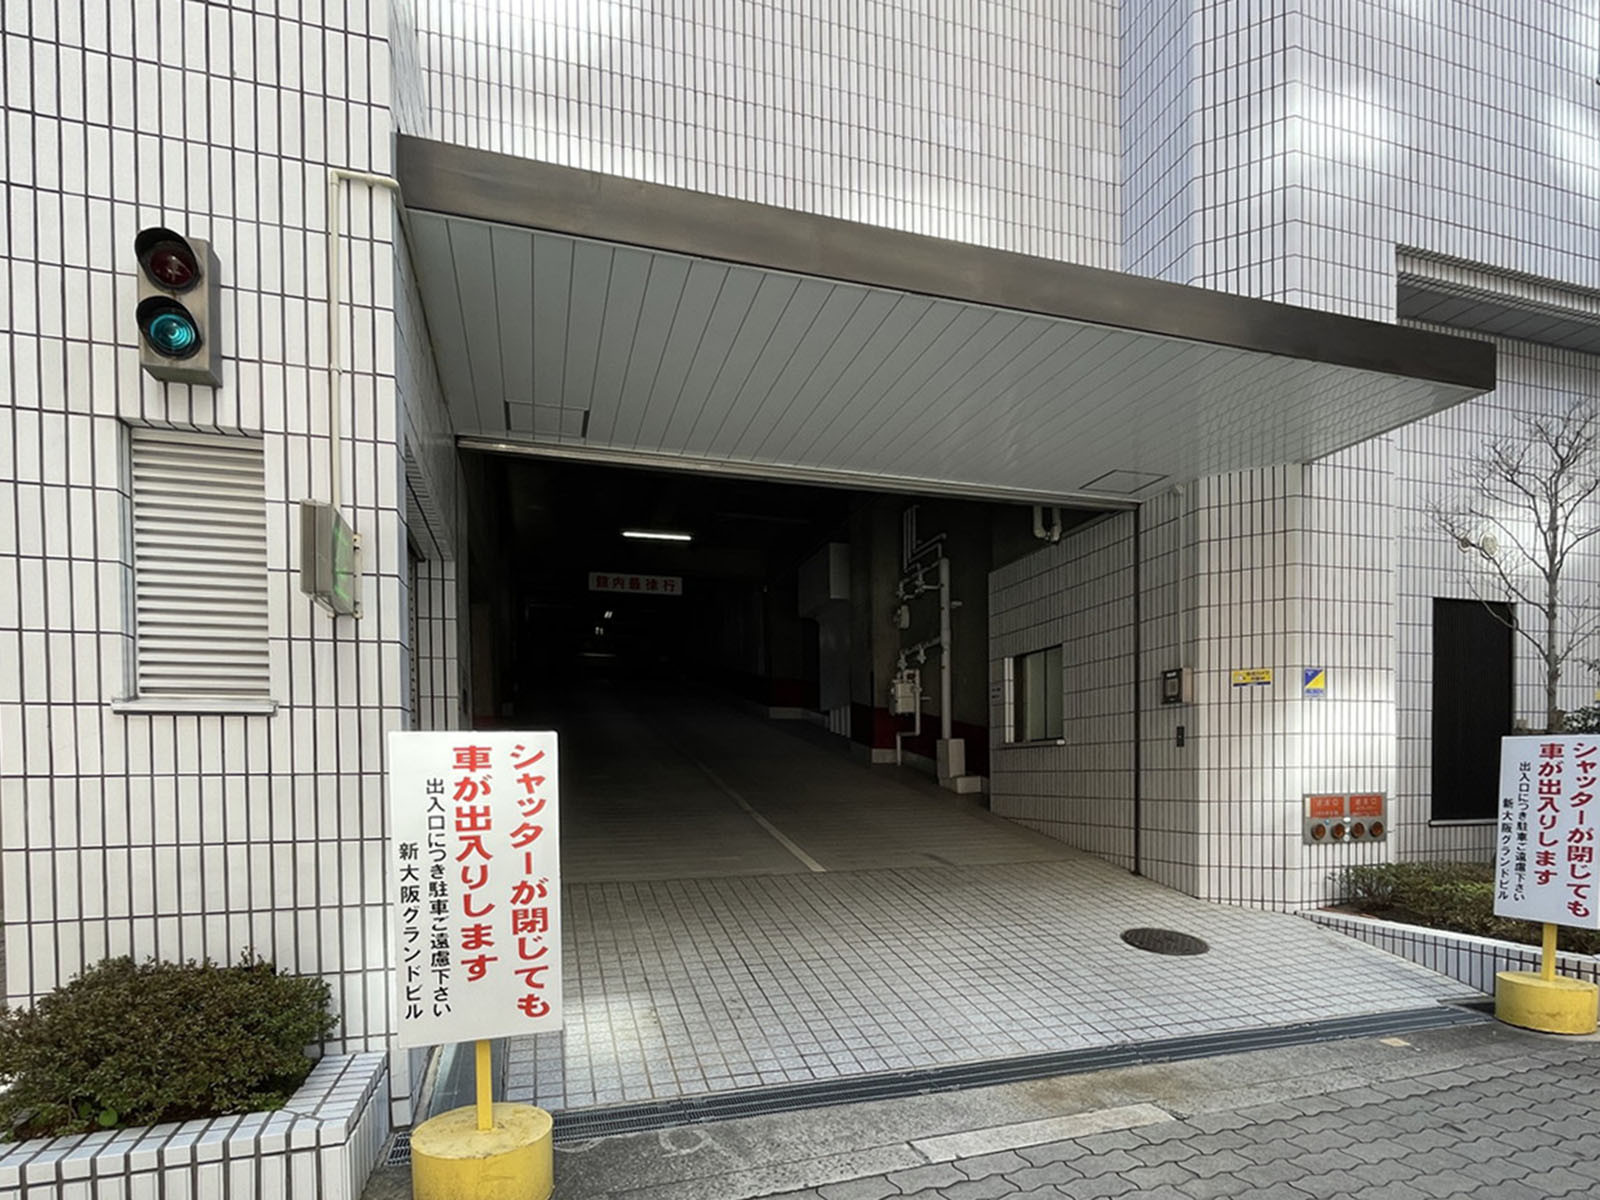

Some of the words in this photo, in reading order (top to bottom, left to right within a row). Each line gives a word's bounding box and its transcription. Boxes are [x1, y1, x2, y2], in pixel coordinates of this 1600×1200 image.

[426, 777, 452, 1017] 出入口につき駐車ご遠慮下さい
[452, 744, 499, 983] 車が出入りします
[509, 744, 551, 1018] シャッターが閉じても
[1534, 742, 1565, 886] 車が出入りします
[1566, 742, 1598, 918] シャッターが閉じても
[399, 842, 424, 1020] 新大阪グランドビル
